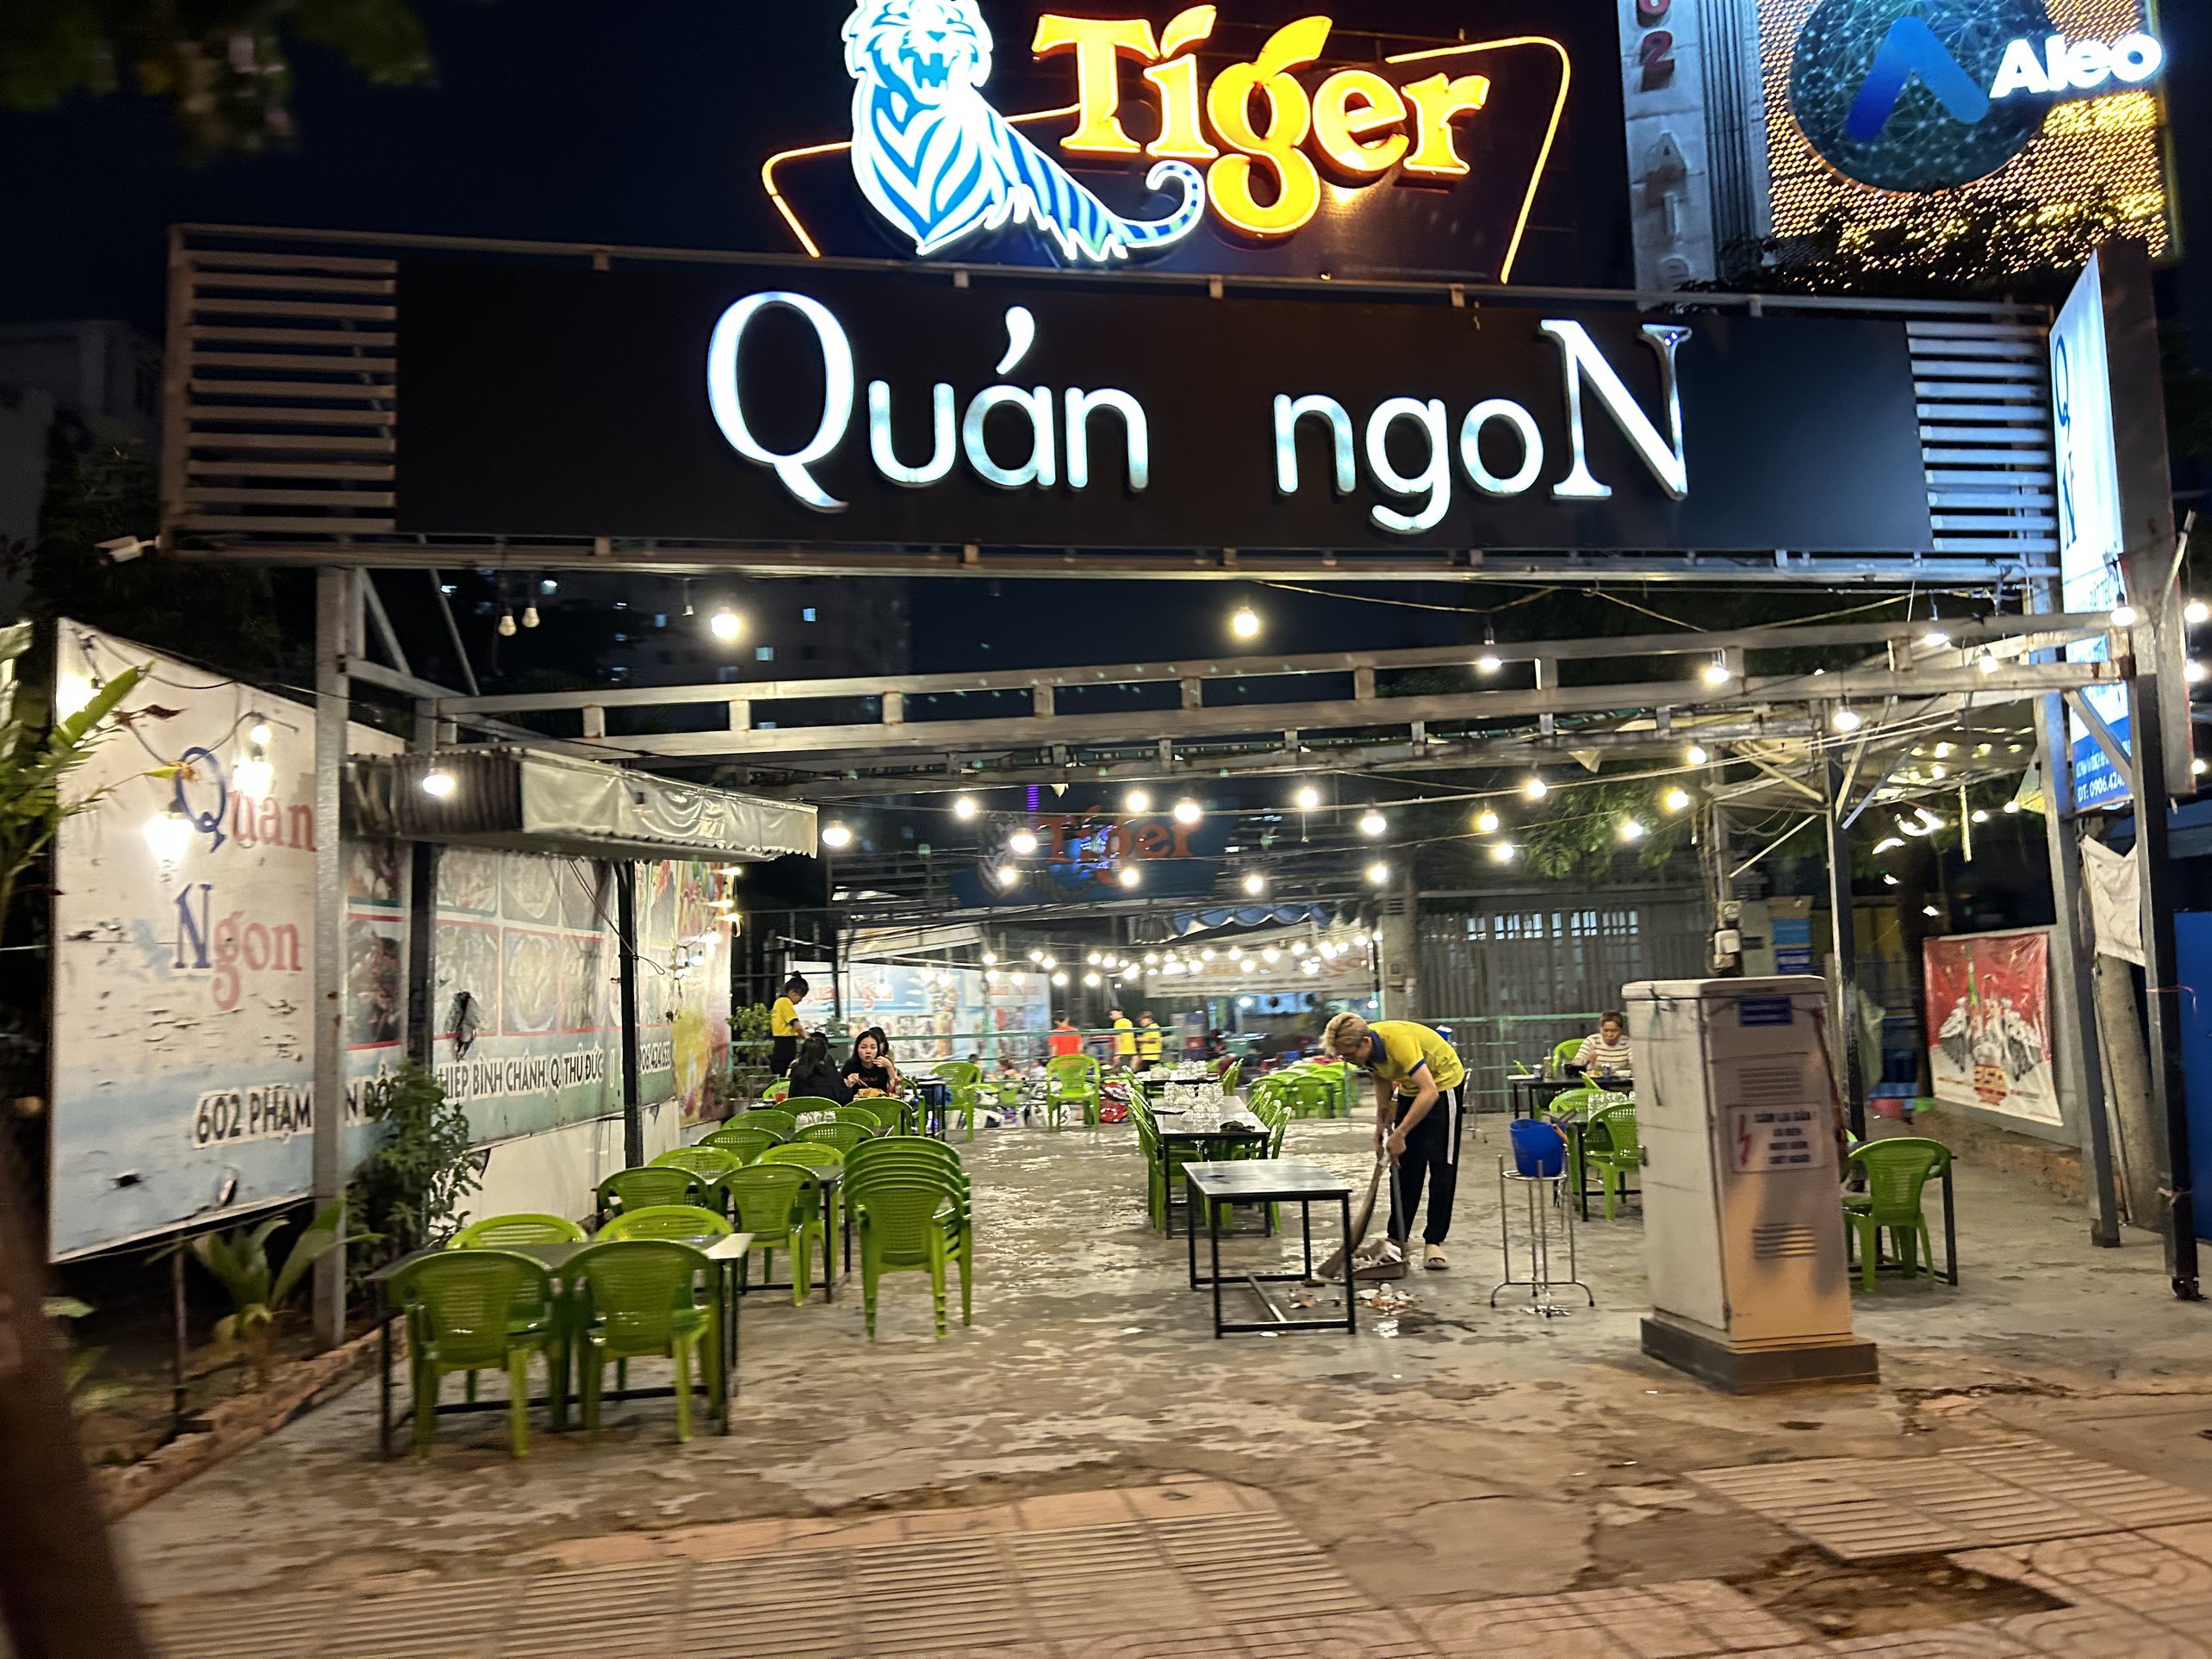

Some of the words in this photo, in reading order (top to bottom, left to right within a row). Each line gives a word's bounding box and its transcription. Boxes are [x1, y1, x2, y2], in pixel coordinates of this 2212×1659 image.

[1031, 4, 1491, 233] Tiger
[1989, 33, 2163, 99] Aleo
[706, 291, 1150, 513] Quán
[1273, 319, 1693, 532] ngoN
[174, 882, 302, 1010] Ngon
[196, 1094, 241, 1144] 602
[473, 1056, 503, 1095] BÌNH
[564, 1047, 584, 1084] THỦ
[585, 1048, 604, 1080] ĐỨC
